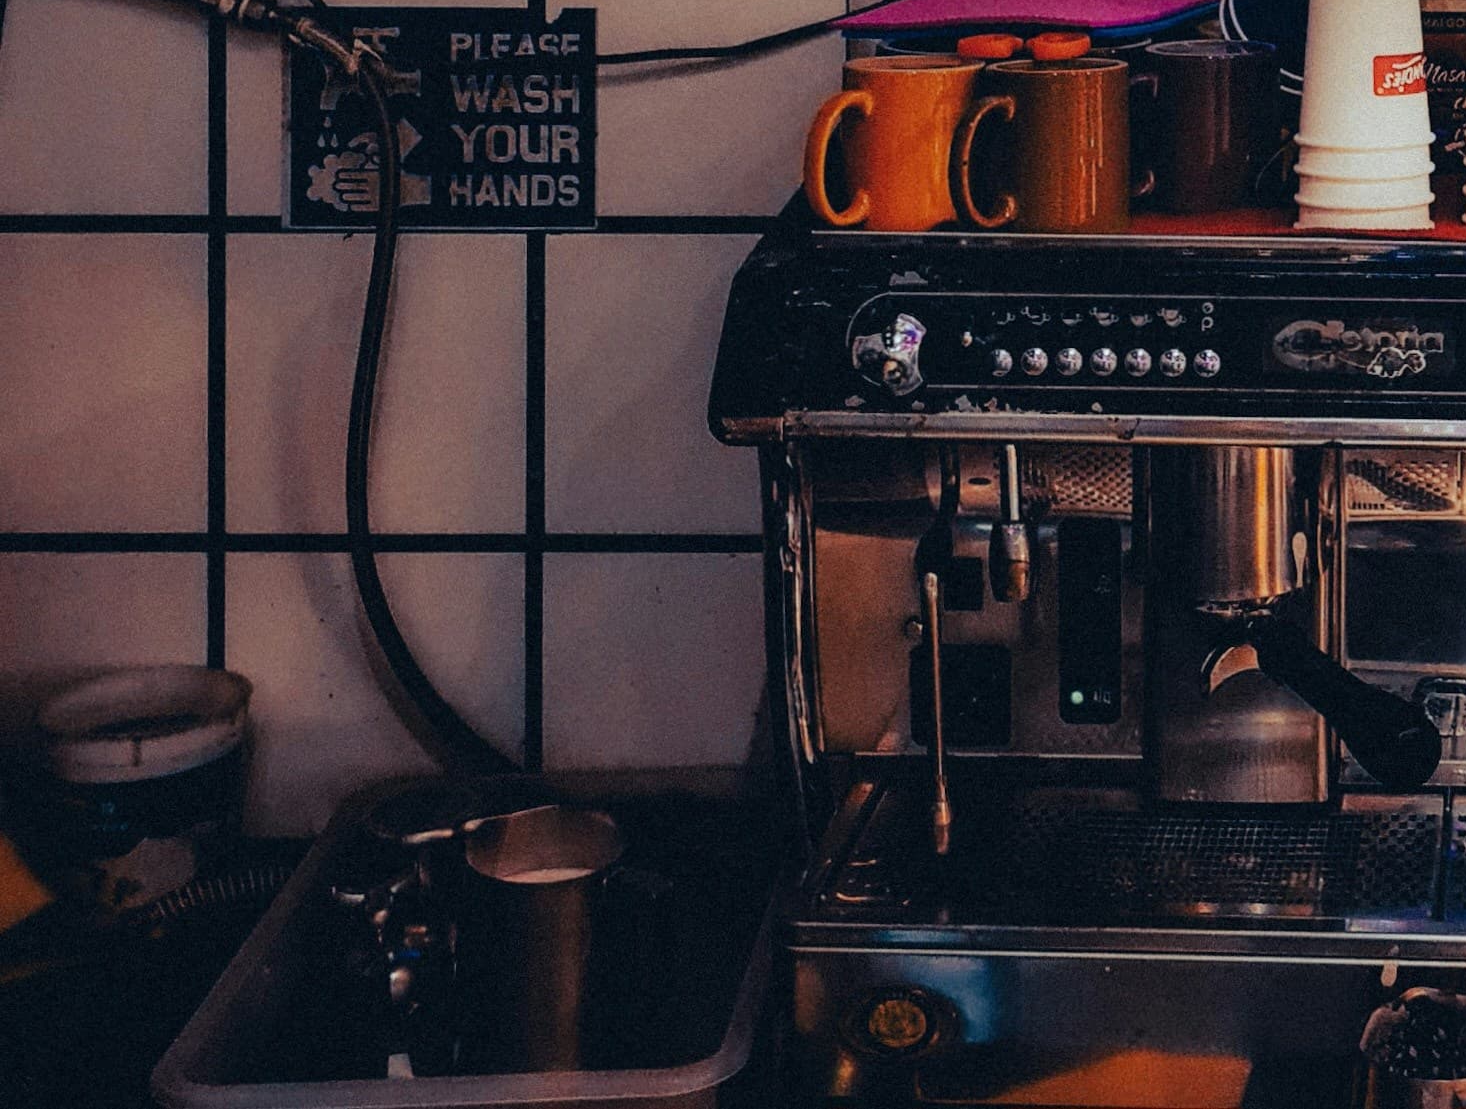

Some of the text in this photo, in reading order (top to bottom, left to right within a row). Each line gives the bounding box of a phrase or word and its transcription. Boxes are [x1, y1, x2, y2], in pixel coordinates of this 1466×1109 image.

[451, 33, 580, 61] PLEASE
[451, 75, 580, 113] WASH
[451, 124, 580, 163] YOUR
[450, 175, 580, 207] HANDS
